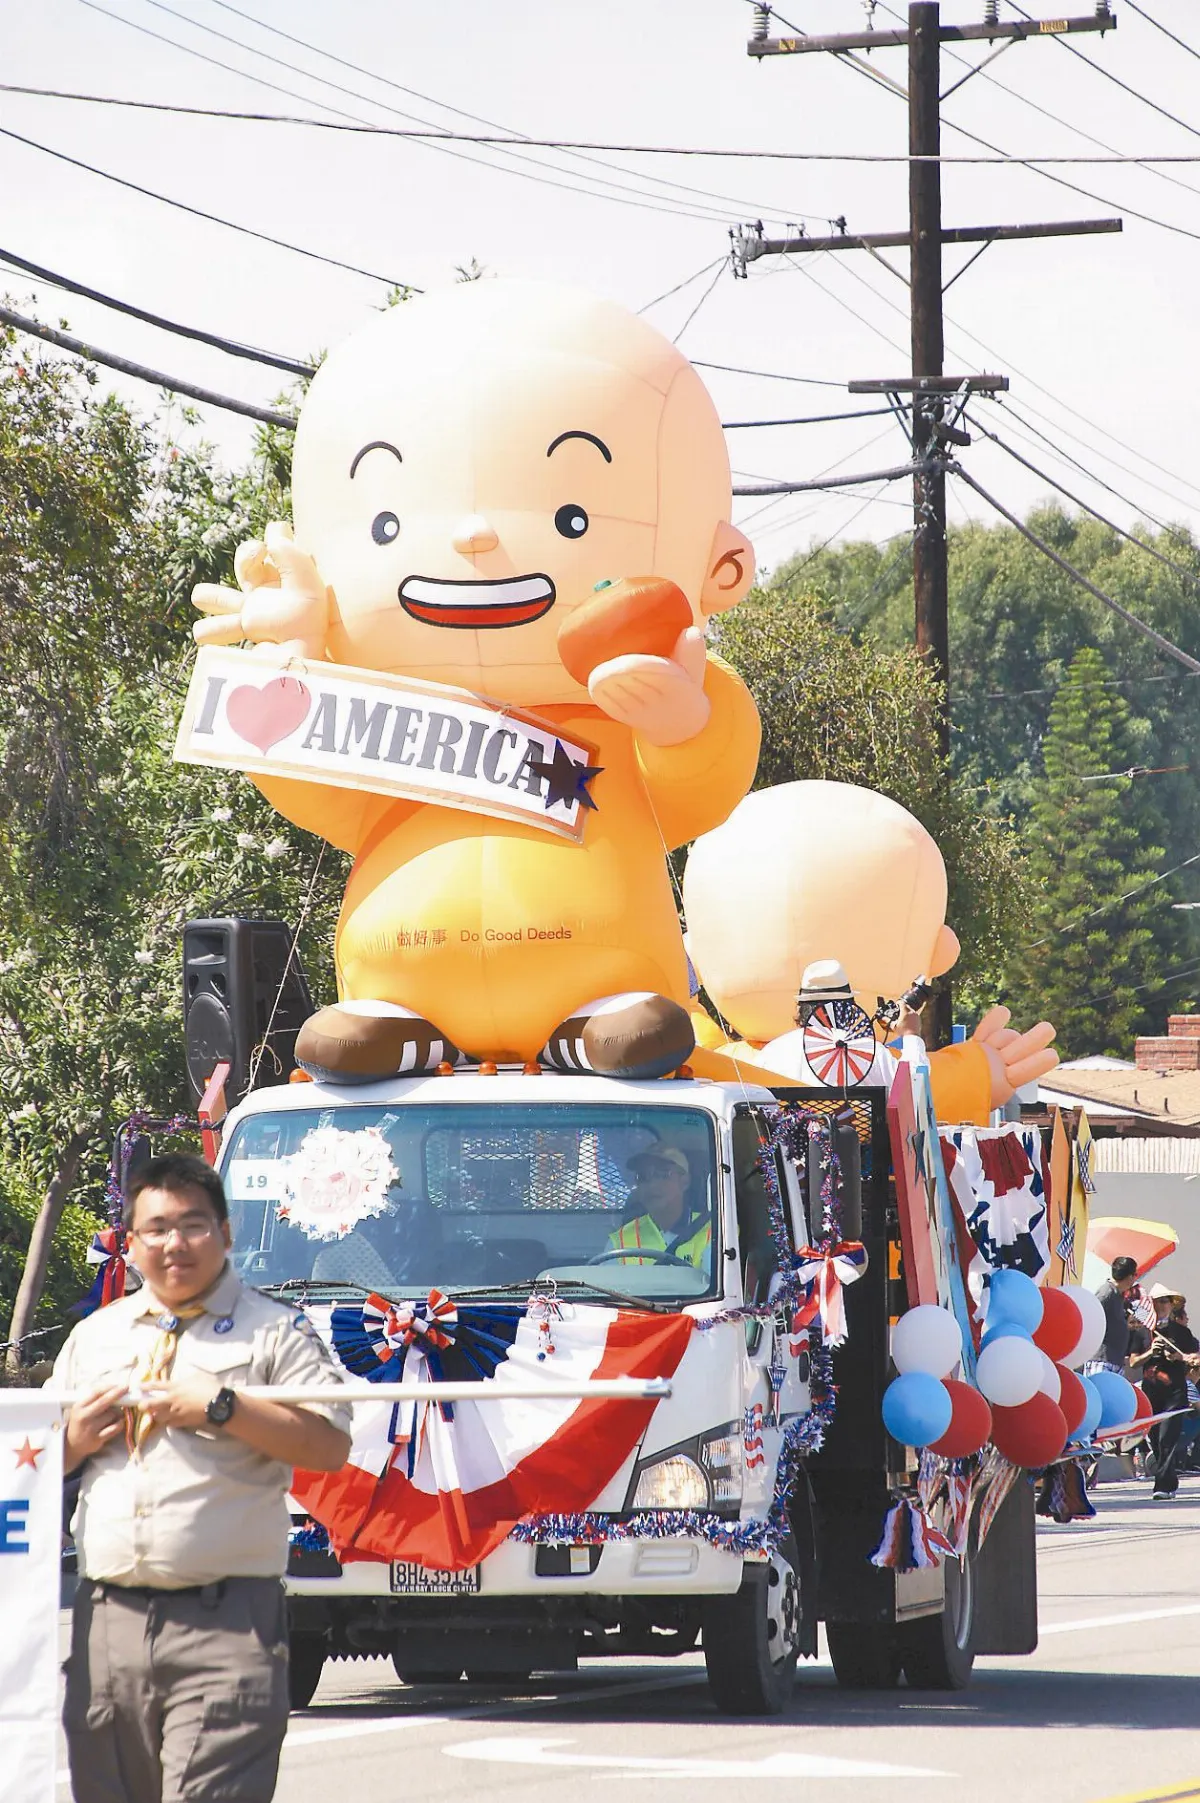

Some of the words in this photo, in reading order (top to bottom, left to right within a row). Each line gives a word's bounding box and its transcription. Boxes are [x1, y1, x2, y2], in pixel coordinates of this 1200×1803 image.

[194, 676, 228, 735] I
[301, 692, 585, 810] AMERICA
[397, 928, 448, 948] 做好事
[460, 929, 480, 942] Do
[485, 928, 522, 942] Good
[527, 926, 572, 941] Deeds
[245, 1175, 268, 1189] 19
[430, 1584, 452, 1593] TRUCK
